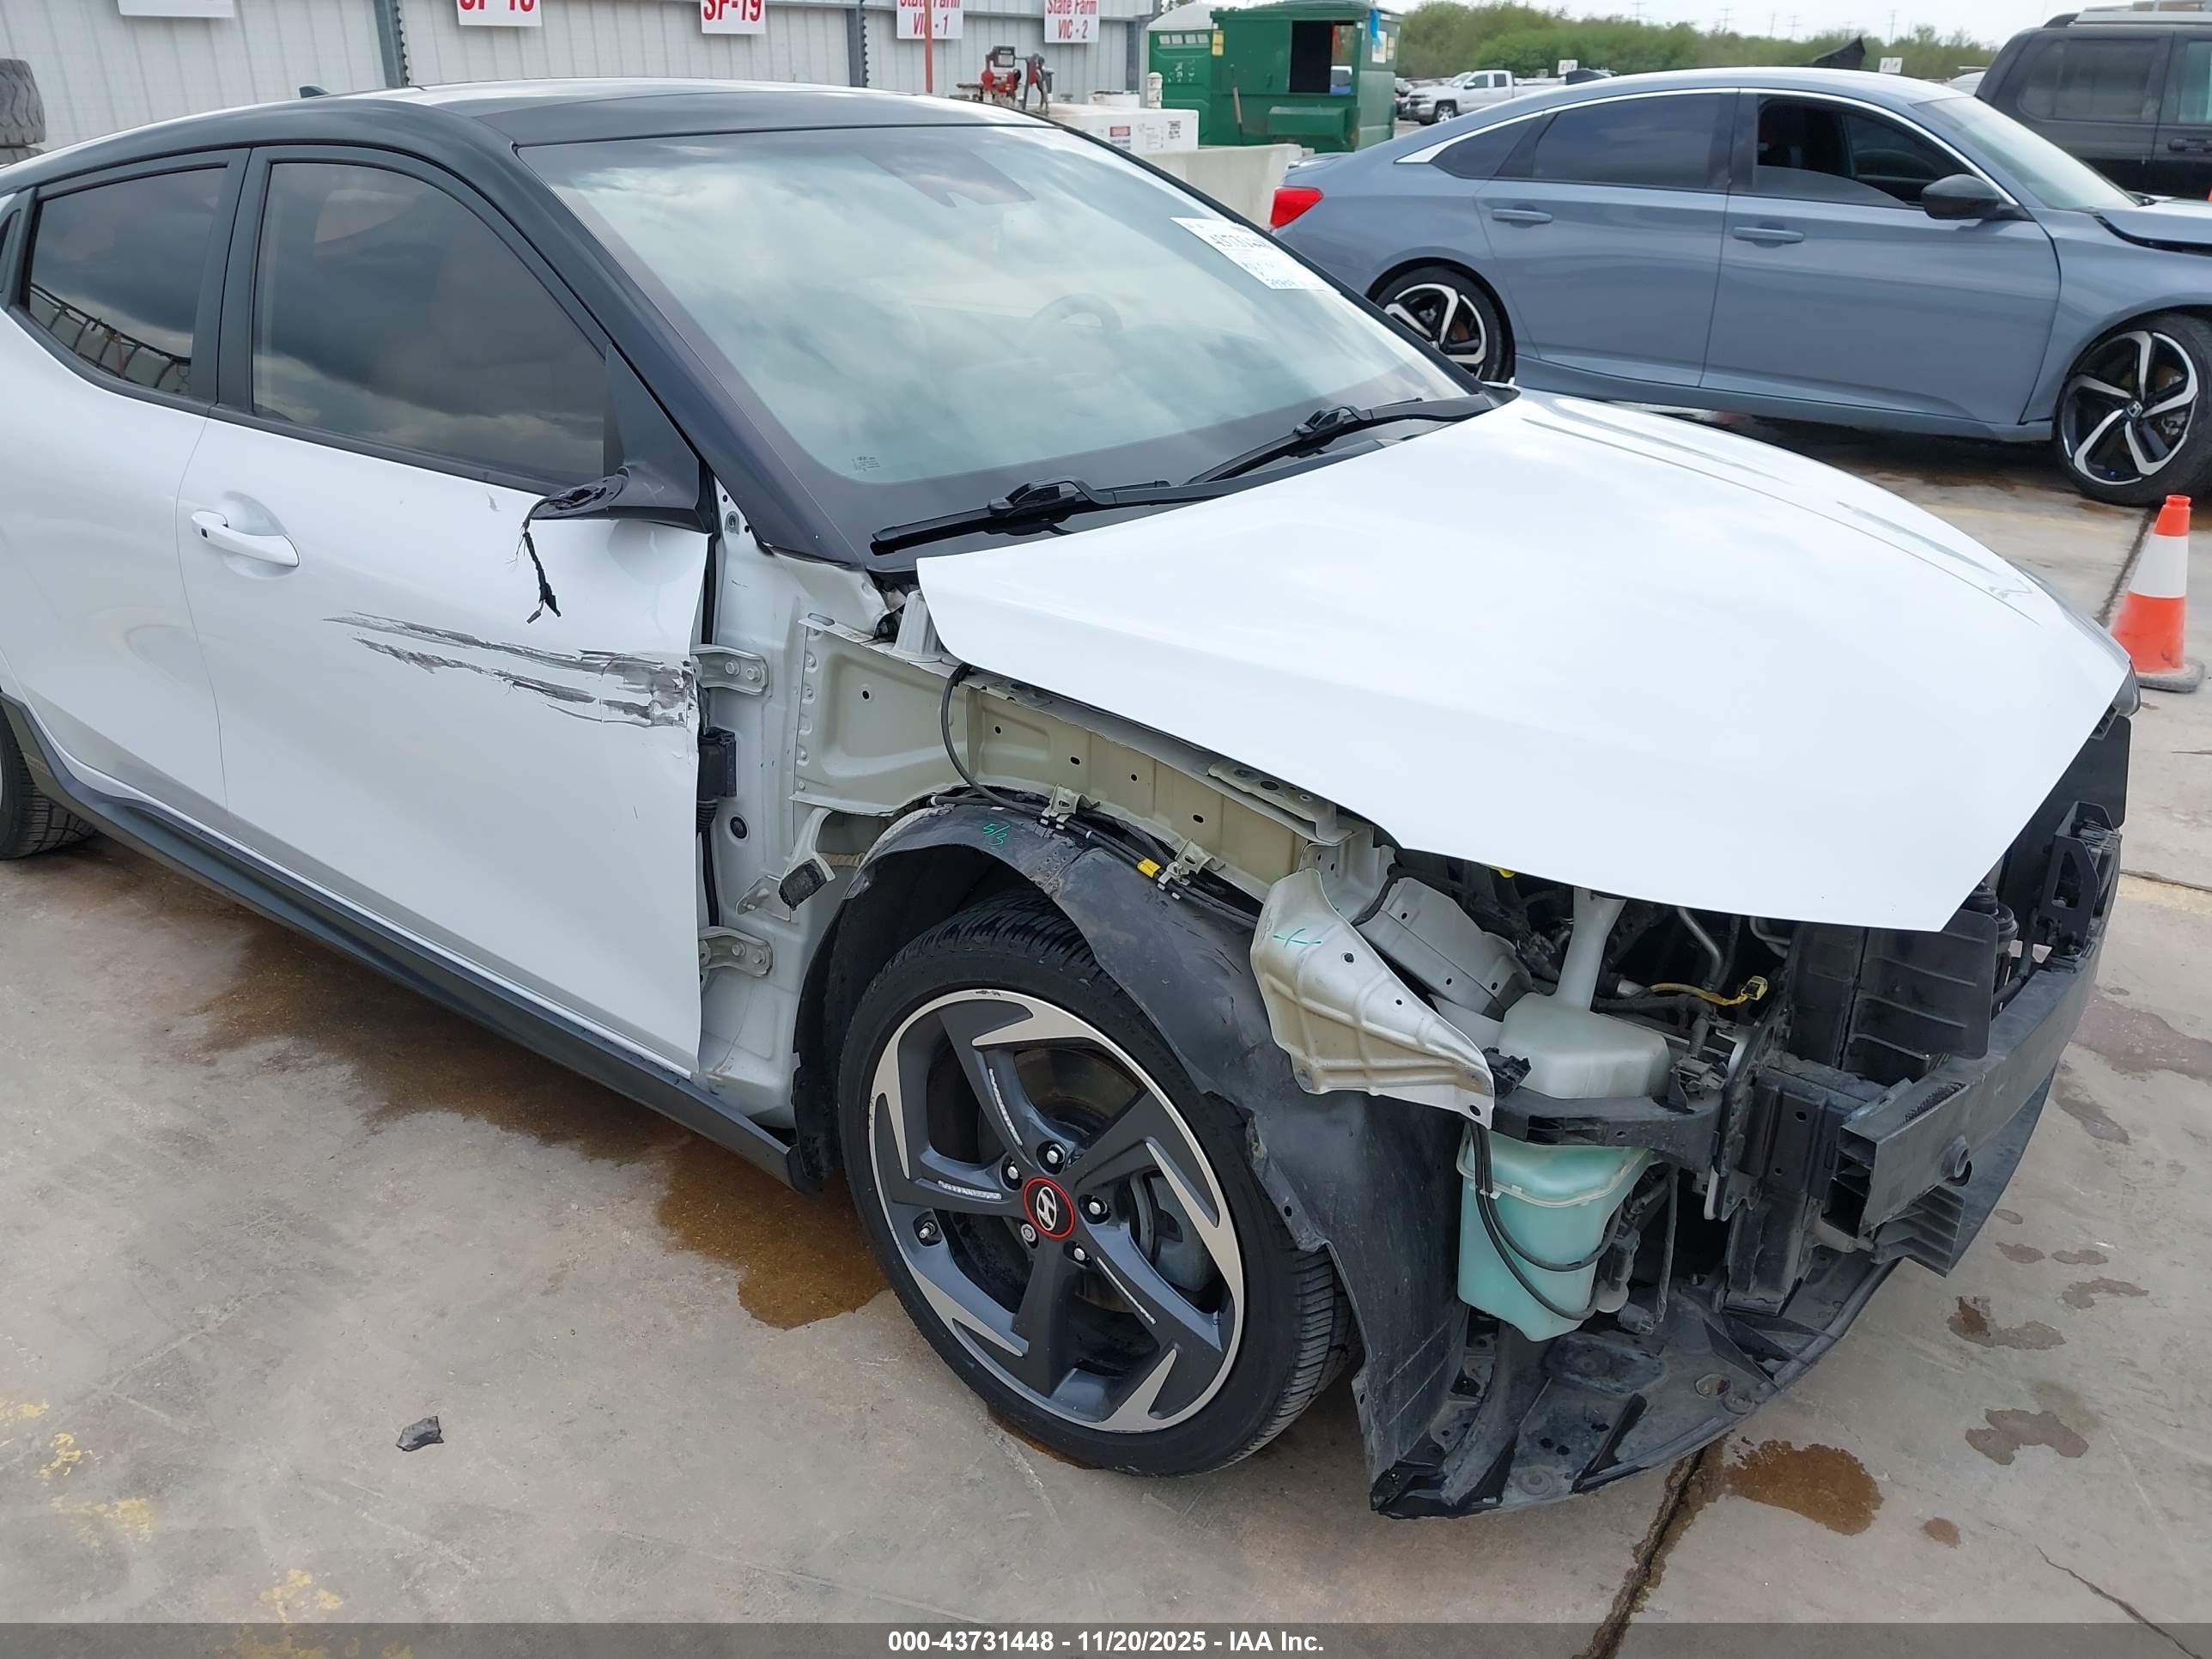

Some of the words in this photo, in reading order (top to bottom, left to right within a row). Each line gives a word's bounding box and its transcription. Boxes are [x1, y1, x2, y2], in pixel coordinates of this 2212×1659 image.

[1047, 0, 1072, 14] State
[1074, 0, 1097, 15] Farm
[943, 14, 949, 35] 1
[1058, 19, 1073, 40] VIC
[1081, 20, 1089, 40] 2
